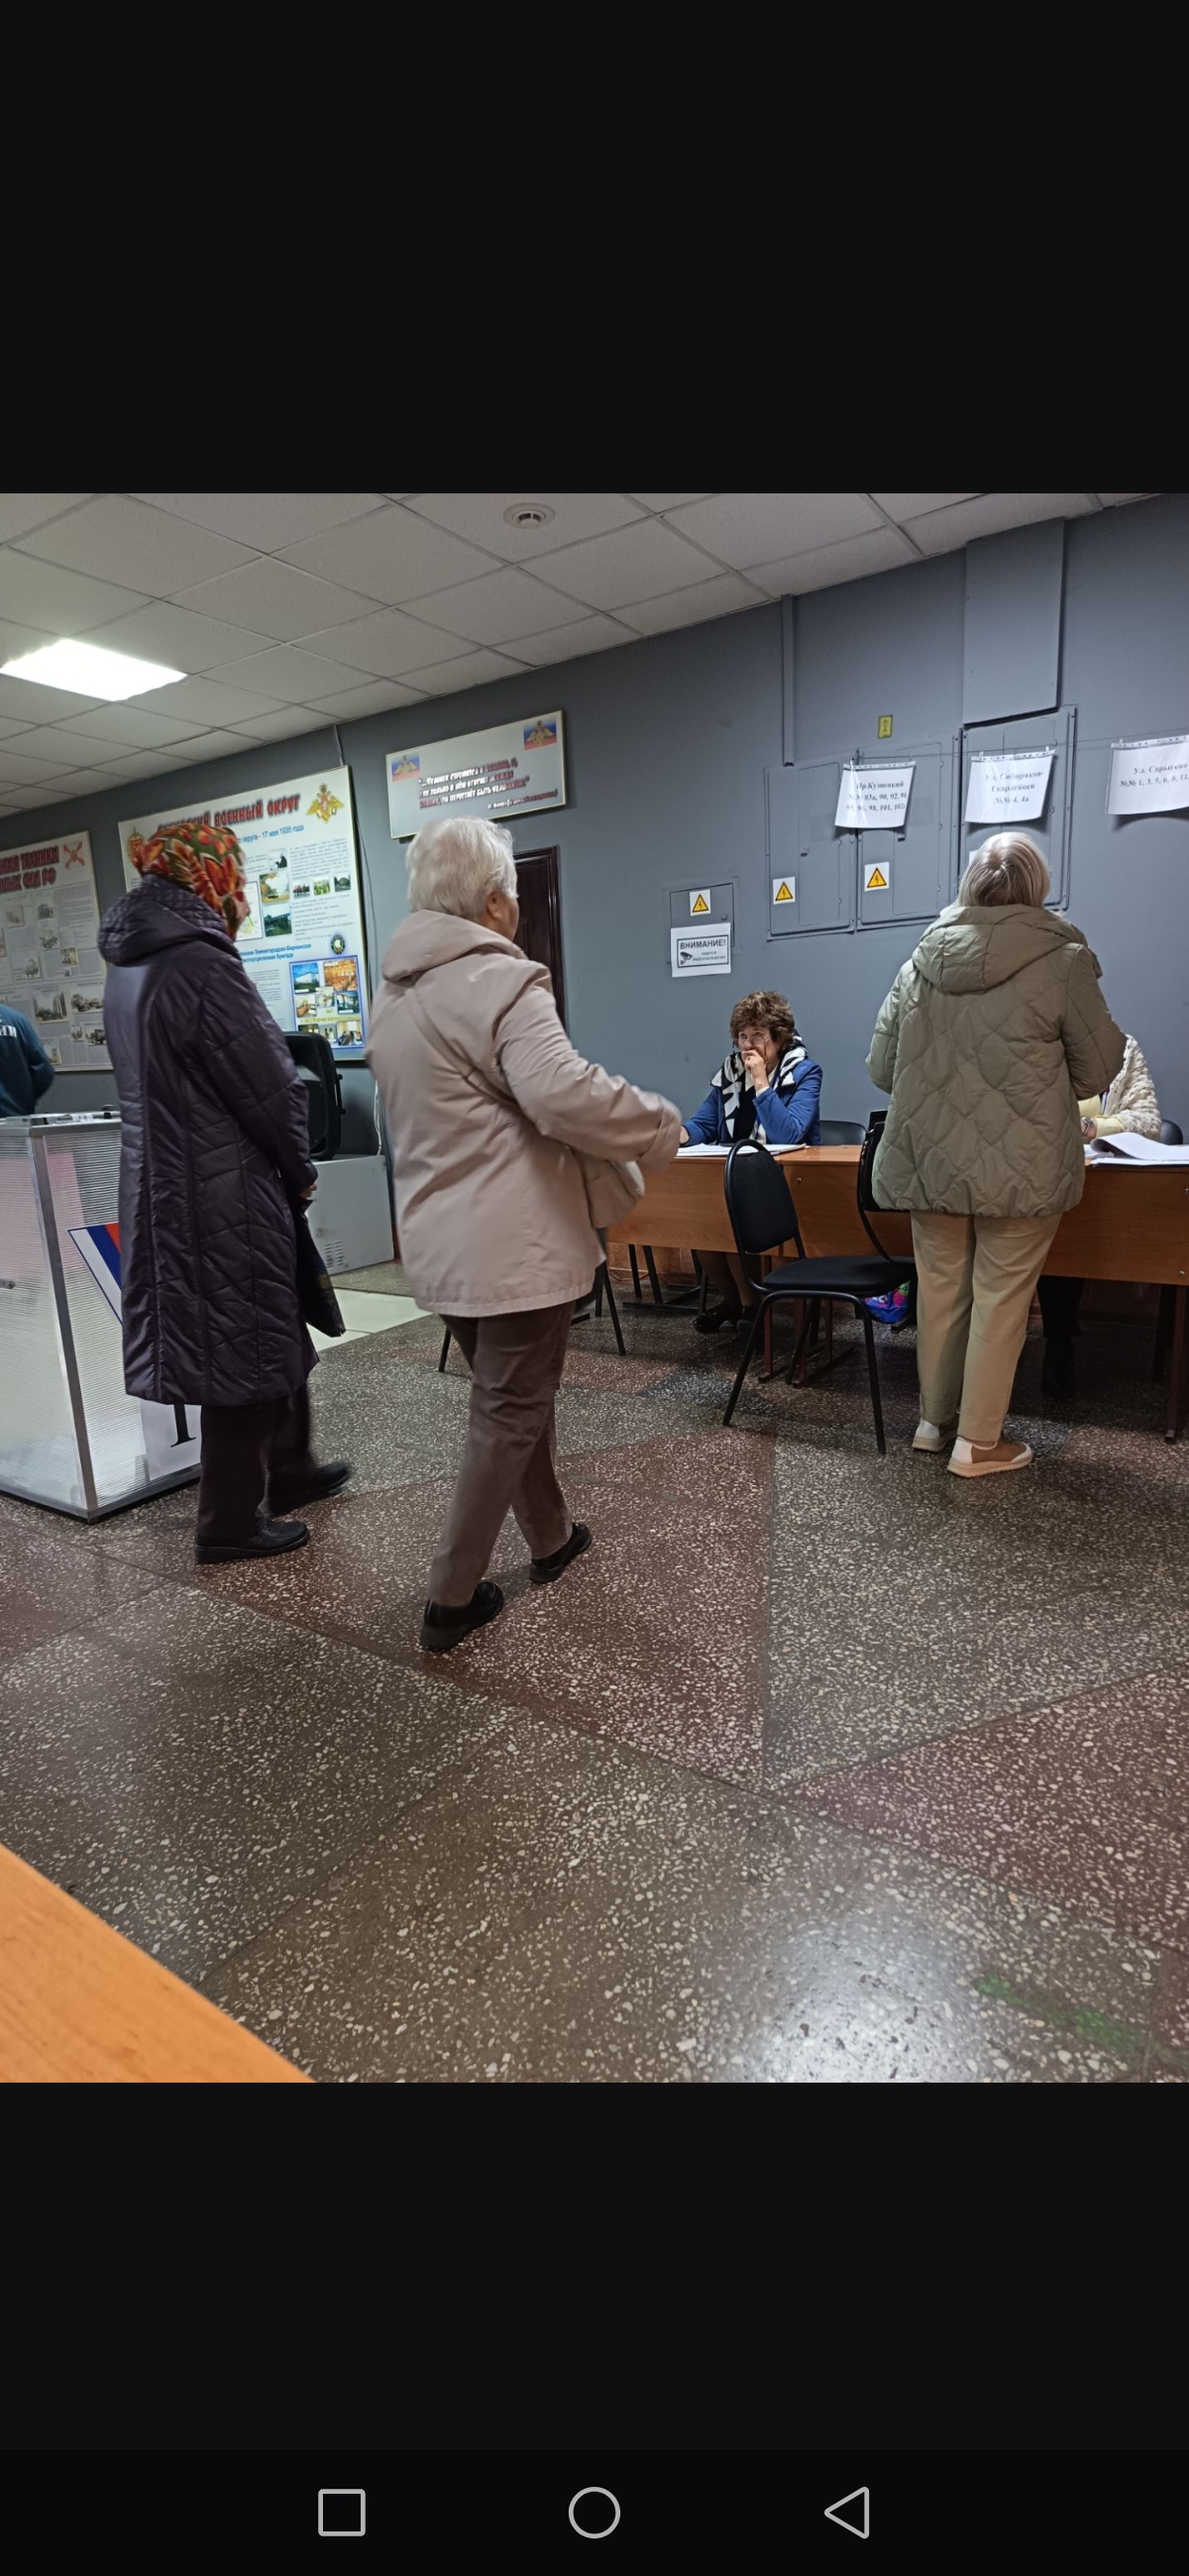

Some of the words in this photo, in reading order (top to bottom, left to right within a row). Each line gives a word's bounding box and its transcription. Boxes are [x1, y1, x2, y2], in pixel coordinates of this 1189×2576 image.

[214, 799, 264, 827] ВОЕННЫЙ
[267, 794, 300, 817] ОКРУГ
[680, 938, 726, 950] ВНИМАНИЕ!
